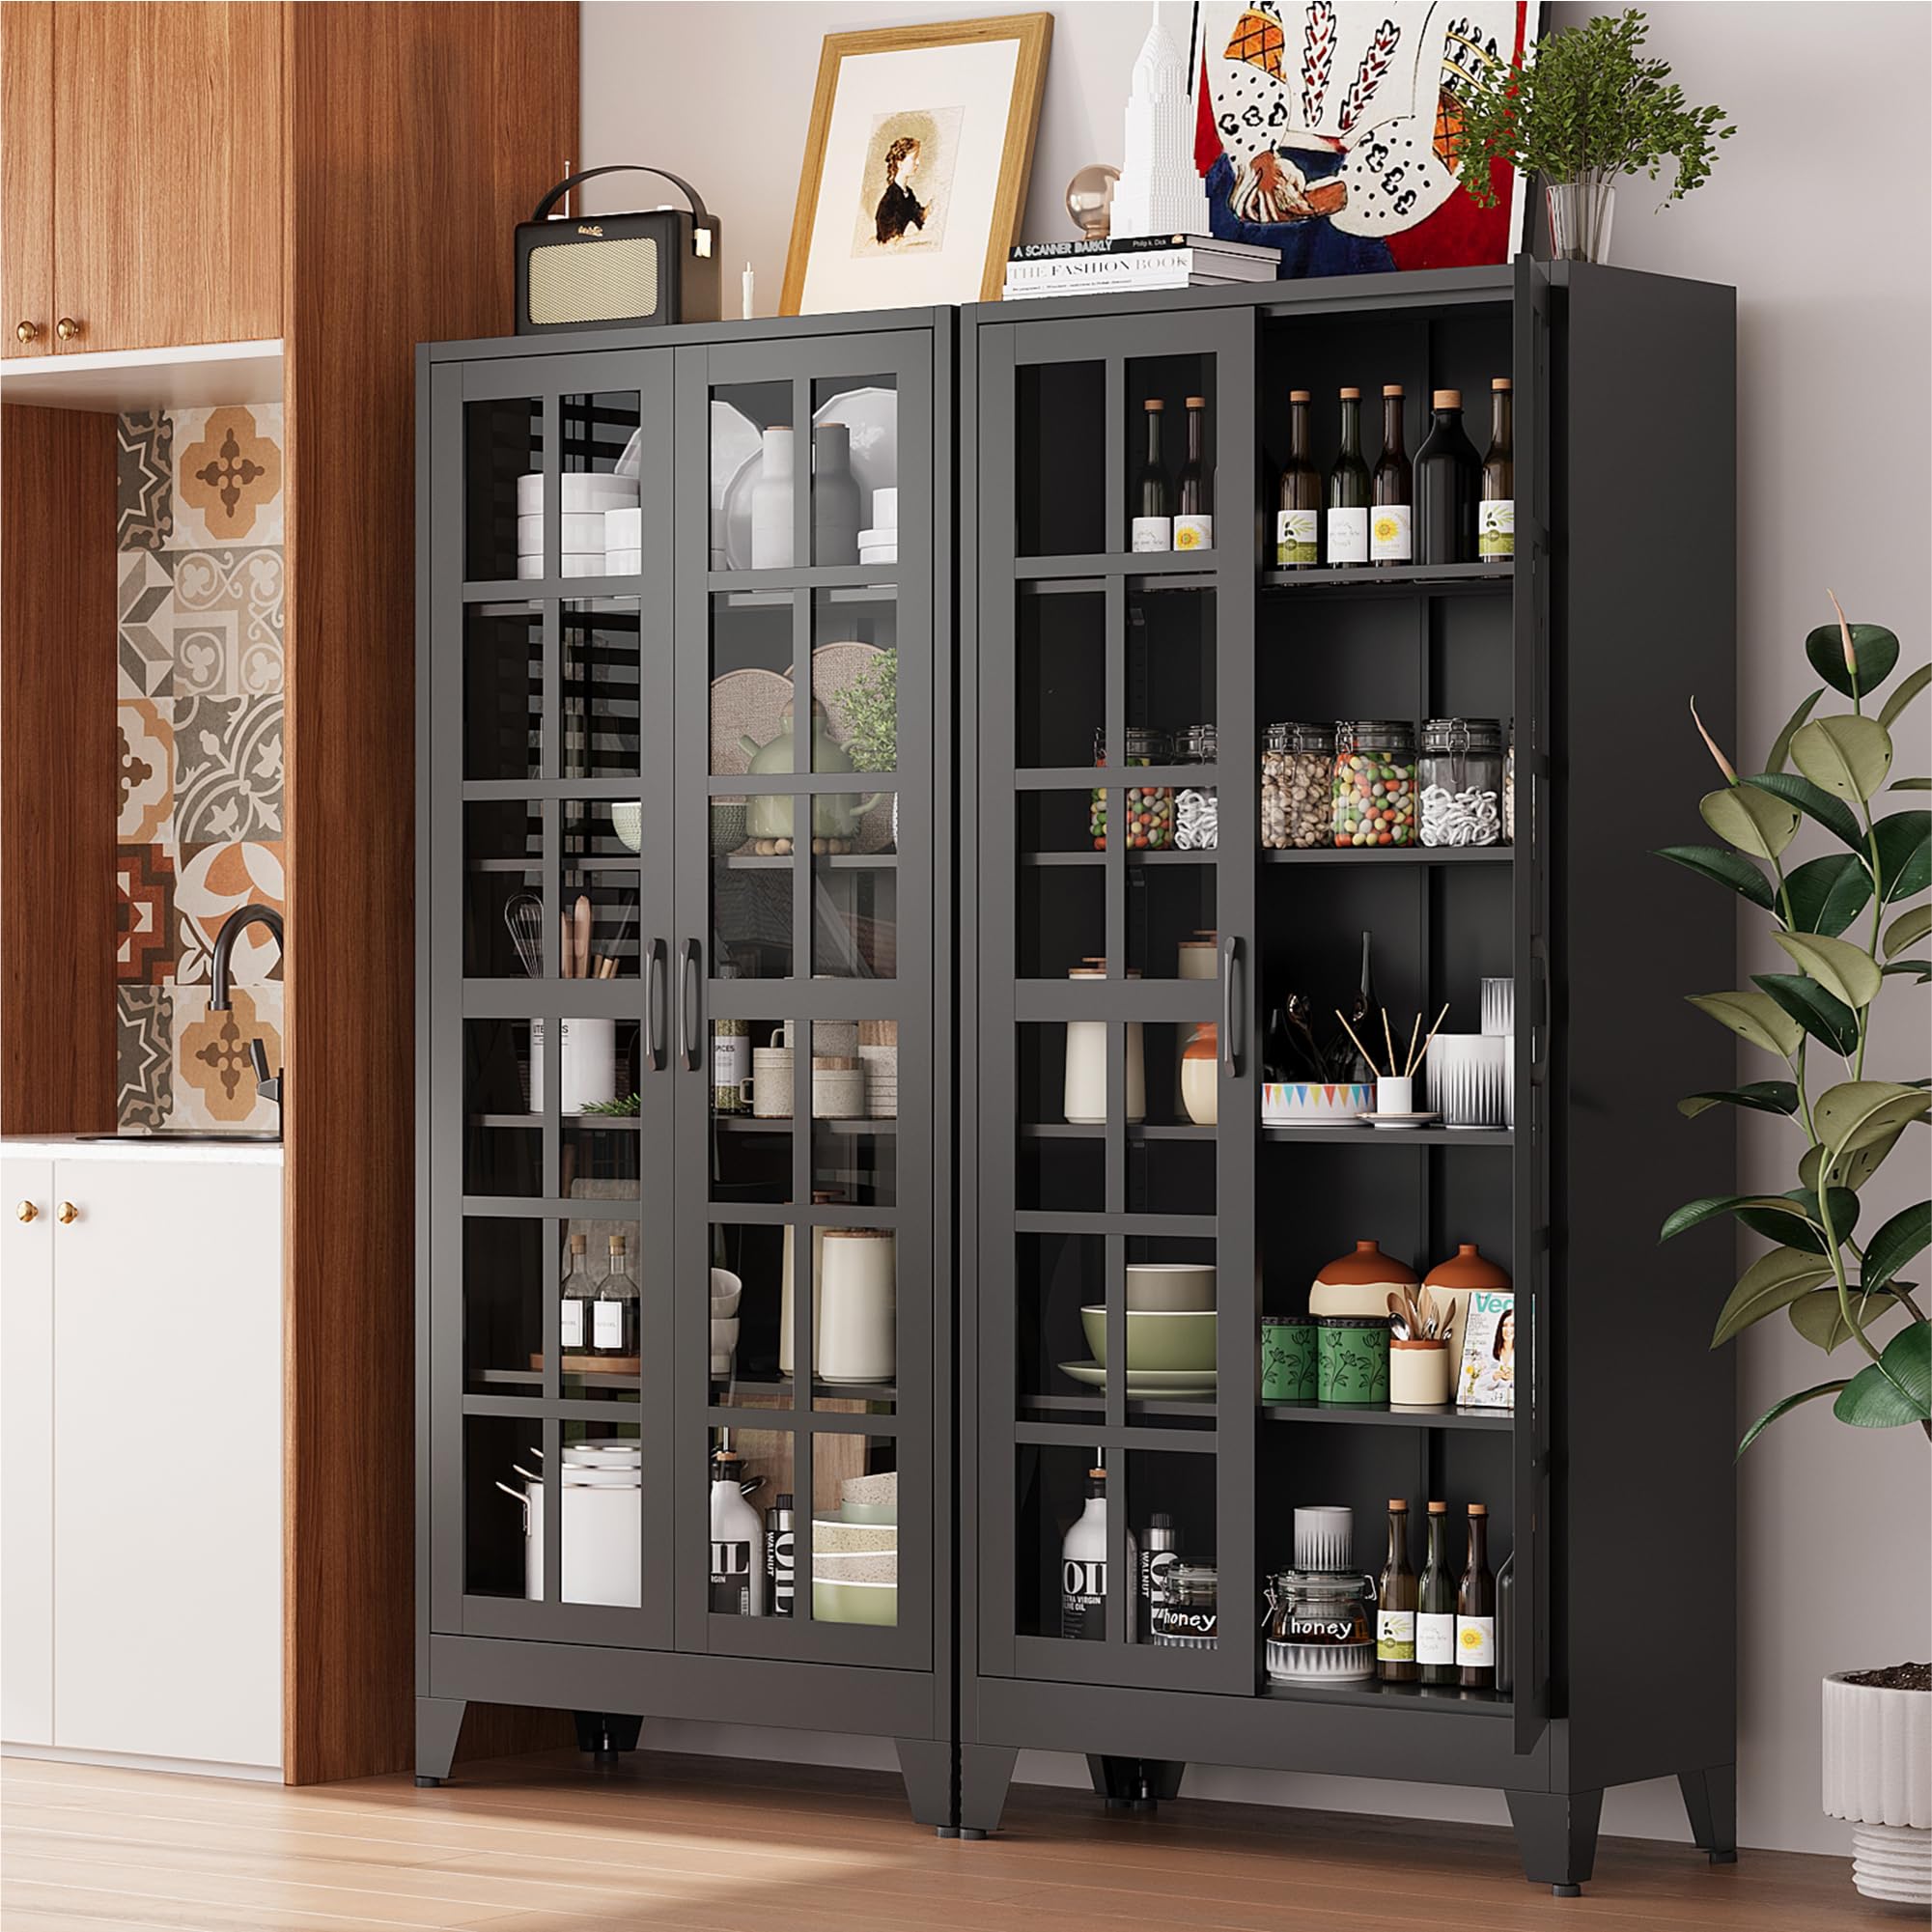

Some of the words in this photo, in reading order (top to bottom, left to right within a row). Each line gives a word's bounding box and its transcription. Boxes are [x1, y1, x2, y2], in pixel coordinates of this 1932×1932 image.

[1013, 246, 1023, 258] A
[1025, 242, 1072, 257] SCANNER
[1074, 239, 1112, 253] DARKLY
[1011, 266, 1047, 279] THE
[1050, 260, 1131, 276] FASHION
[1135, 256, 1189, 270] BOOK
[1141, 1551, 1150, 1598] WALNUT
[1075, 1603, 1086, 1611] OIL
[1077, 1596, 1102, 1605] VIRGIN
[1163, 1608, 1217, 1632] honey
[1291, 1616, 1352, 1639] honey
